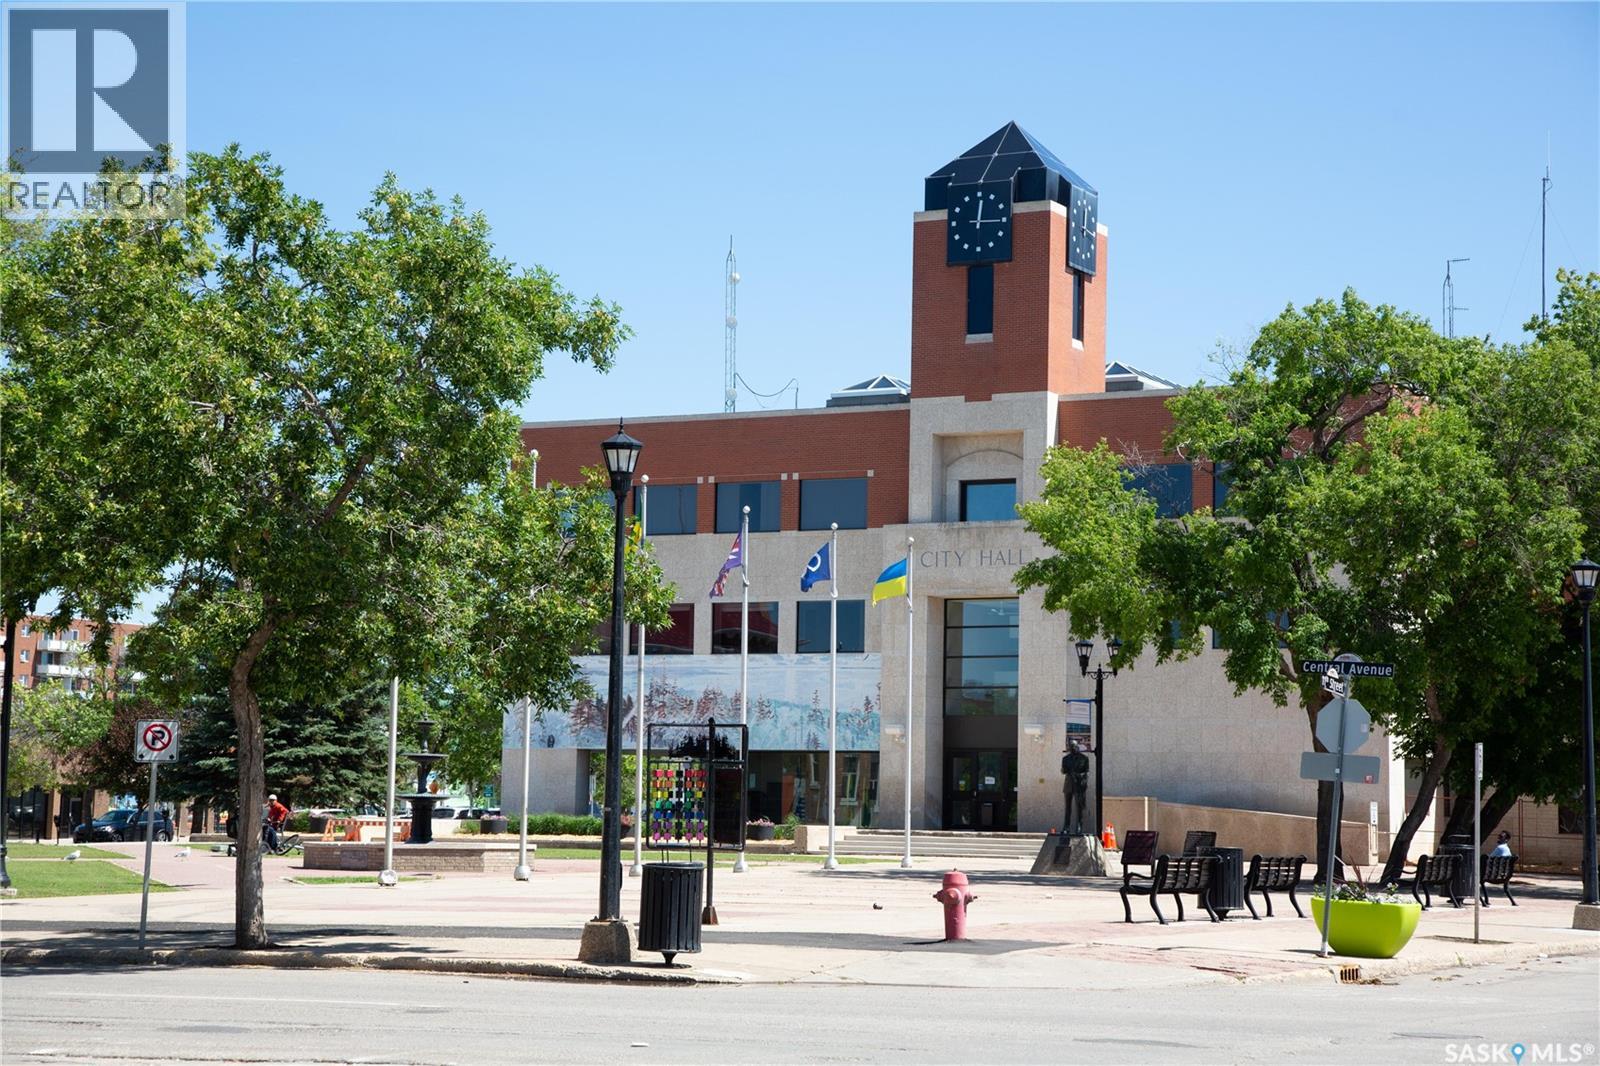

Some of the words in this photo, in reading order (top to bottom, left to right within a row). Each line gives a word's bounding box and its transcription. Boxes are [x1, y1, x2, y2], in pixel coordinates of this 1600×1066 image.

[920, 551, 965, 568] CITY
[980, 549, 1028, 566] HALL
[1350, 663, 1393, 676] Avenue
